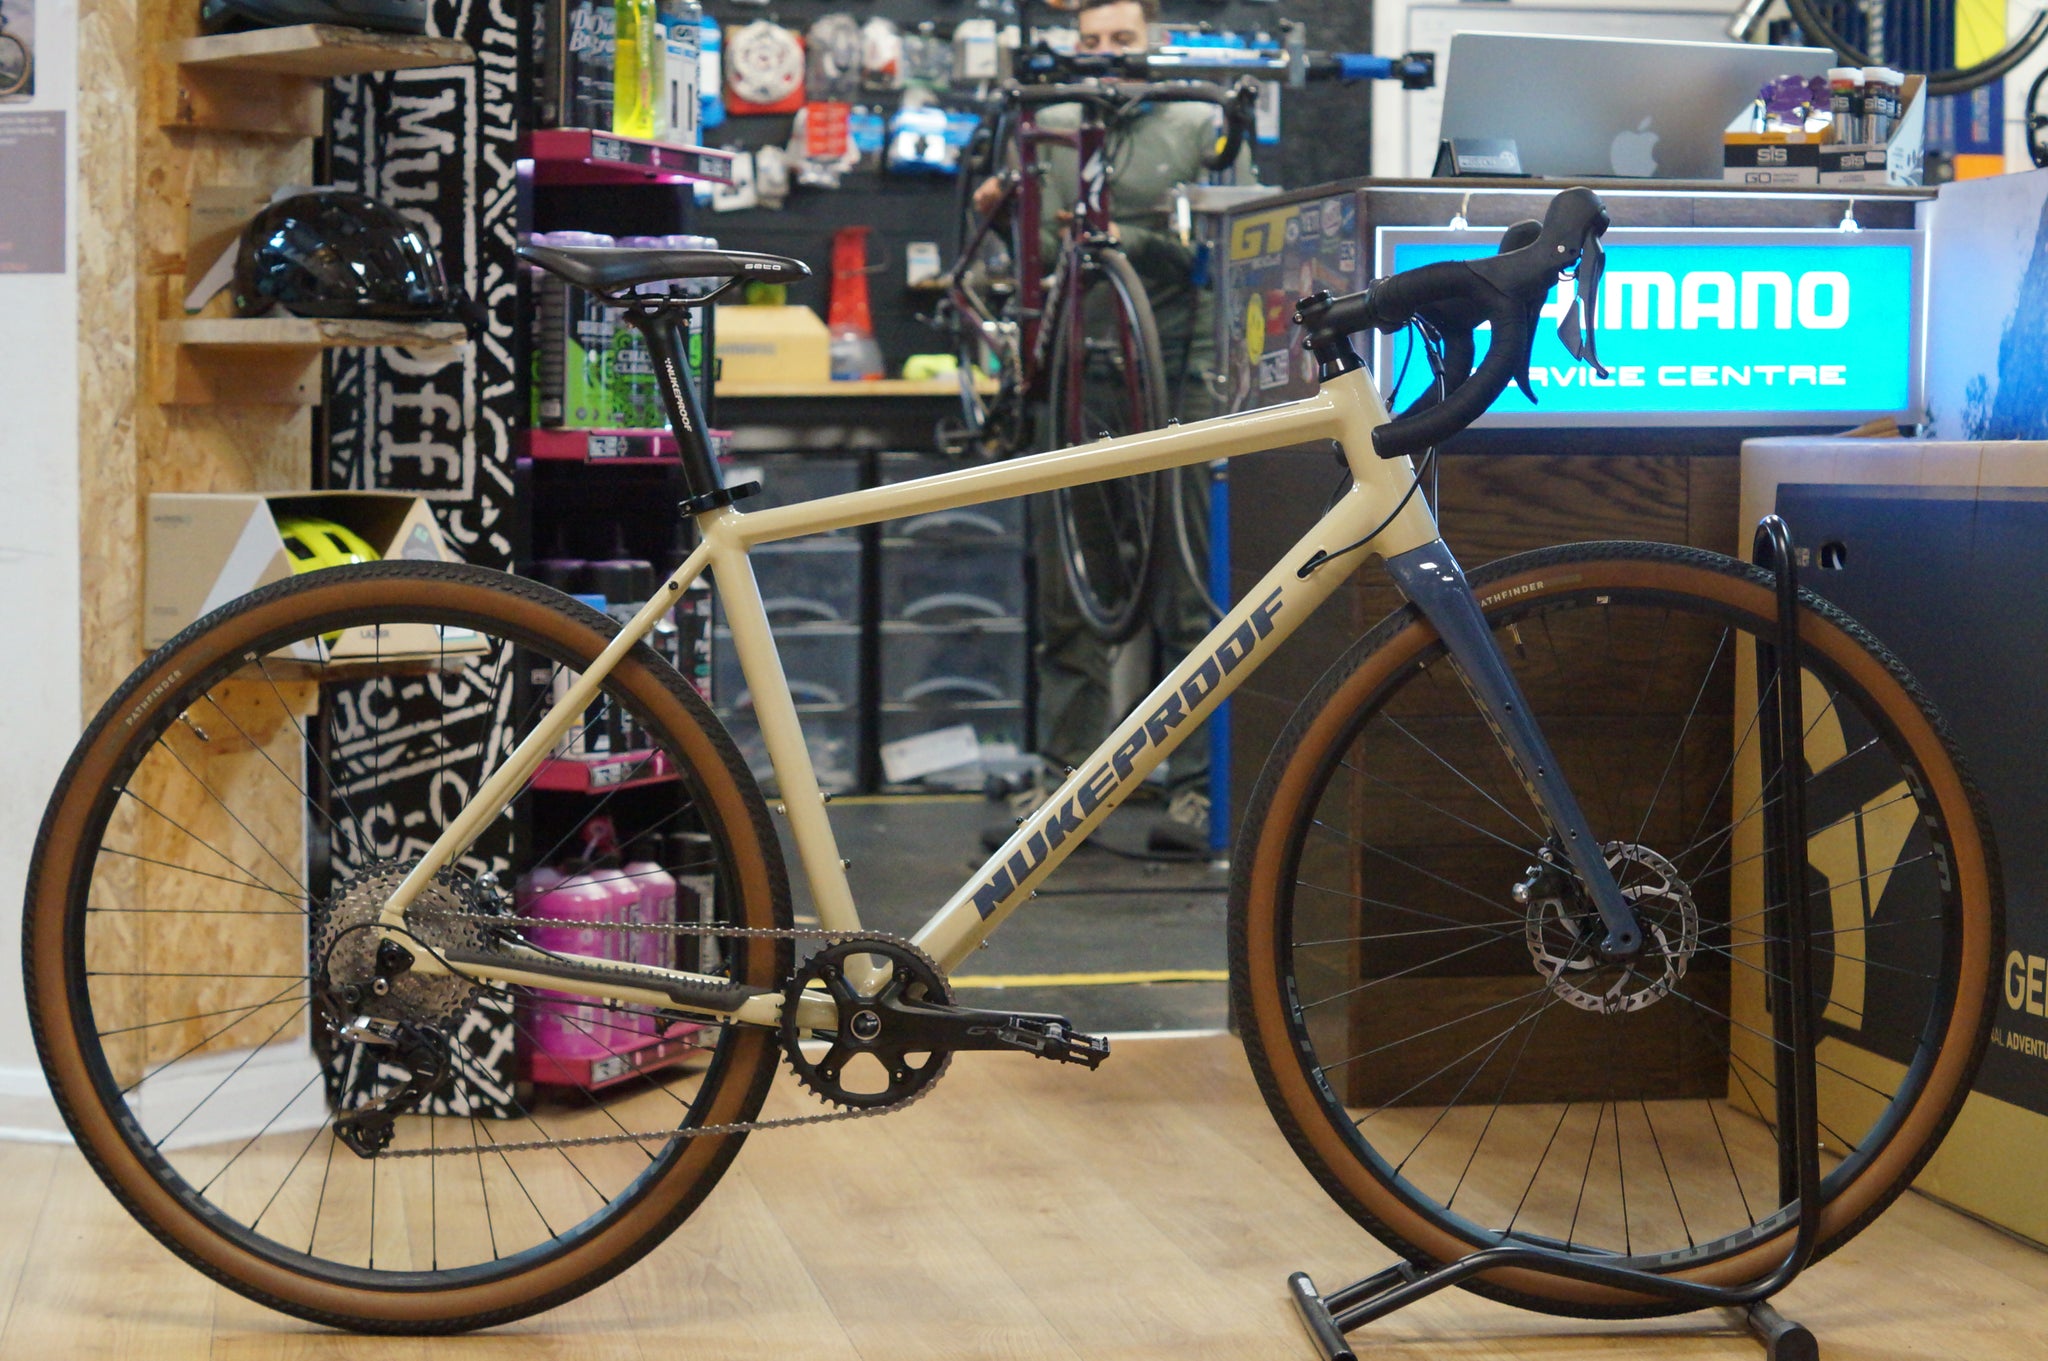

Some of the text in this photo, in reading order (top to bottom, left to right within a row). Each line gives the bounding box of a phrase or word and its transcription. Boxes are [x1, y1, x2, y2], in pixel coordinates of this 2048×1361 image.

[1231, 205, 1299, 260] GT
[664, 363, 693, 433] NUKEPROOF
[1657, 365, 1847, 388] CENTRE
[1480, 580, 1545, 608] ATHFINDER
[125, 669, 183, 727] PATHFINDER
[962, 585, 1284, 922] NUKEPROOF
